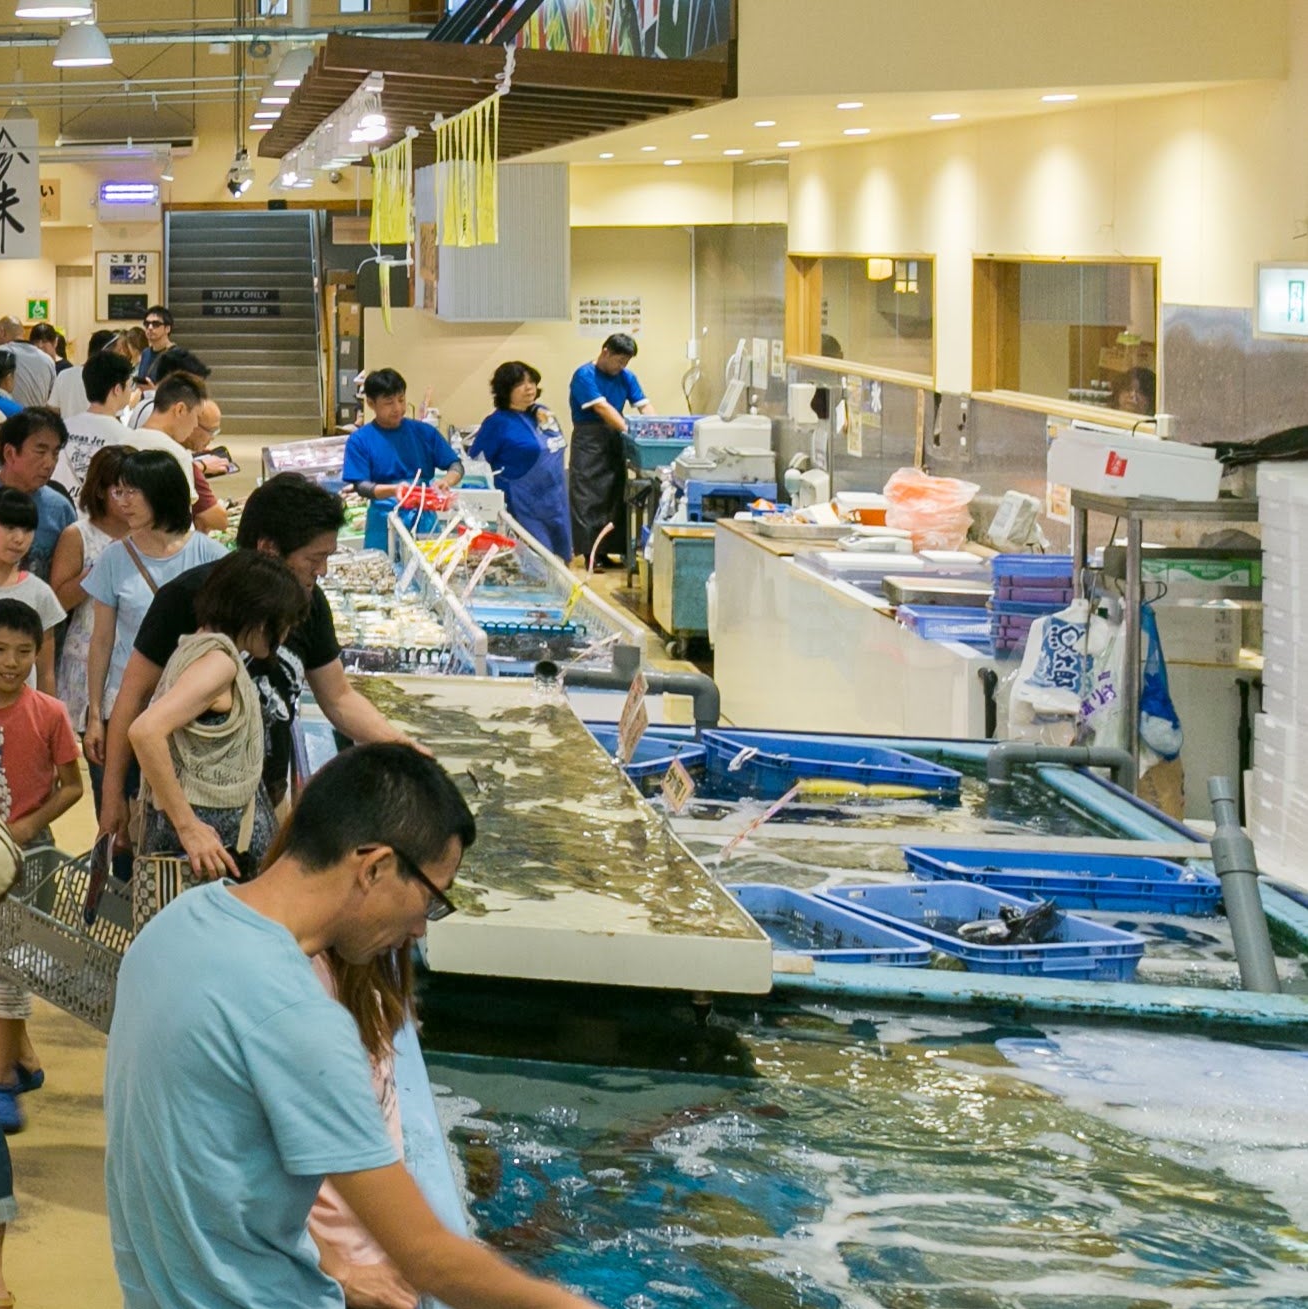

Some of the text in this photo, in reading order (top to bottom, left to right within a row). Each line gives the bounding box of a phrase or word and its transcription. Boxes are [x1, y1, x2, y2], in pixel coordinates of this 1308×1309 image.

[110, 254, 148, 264] ご案内
[212, 291, 269, 299] STAFF ONLY
[214, 306, 268, 315] 立ち入り禁止
